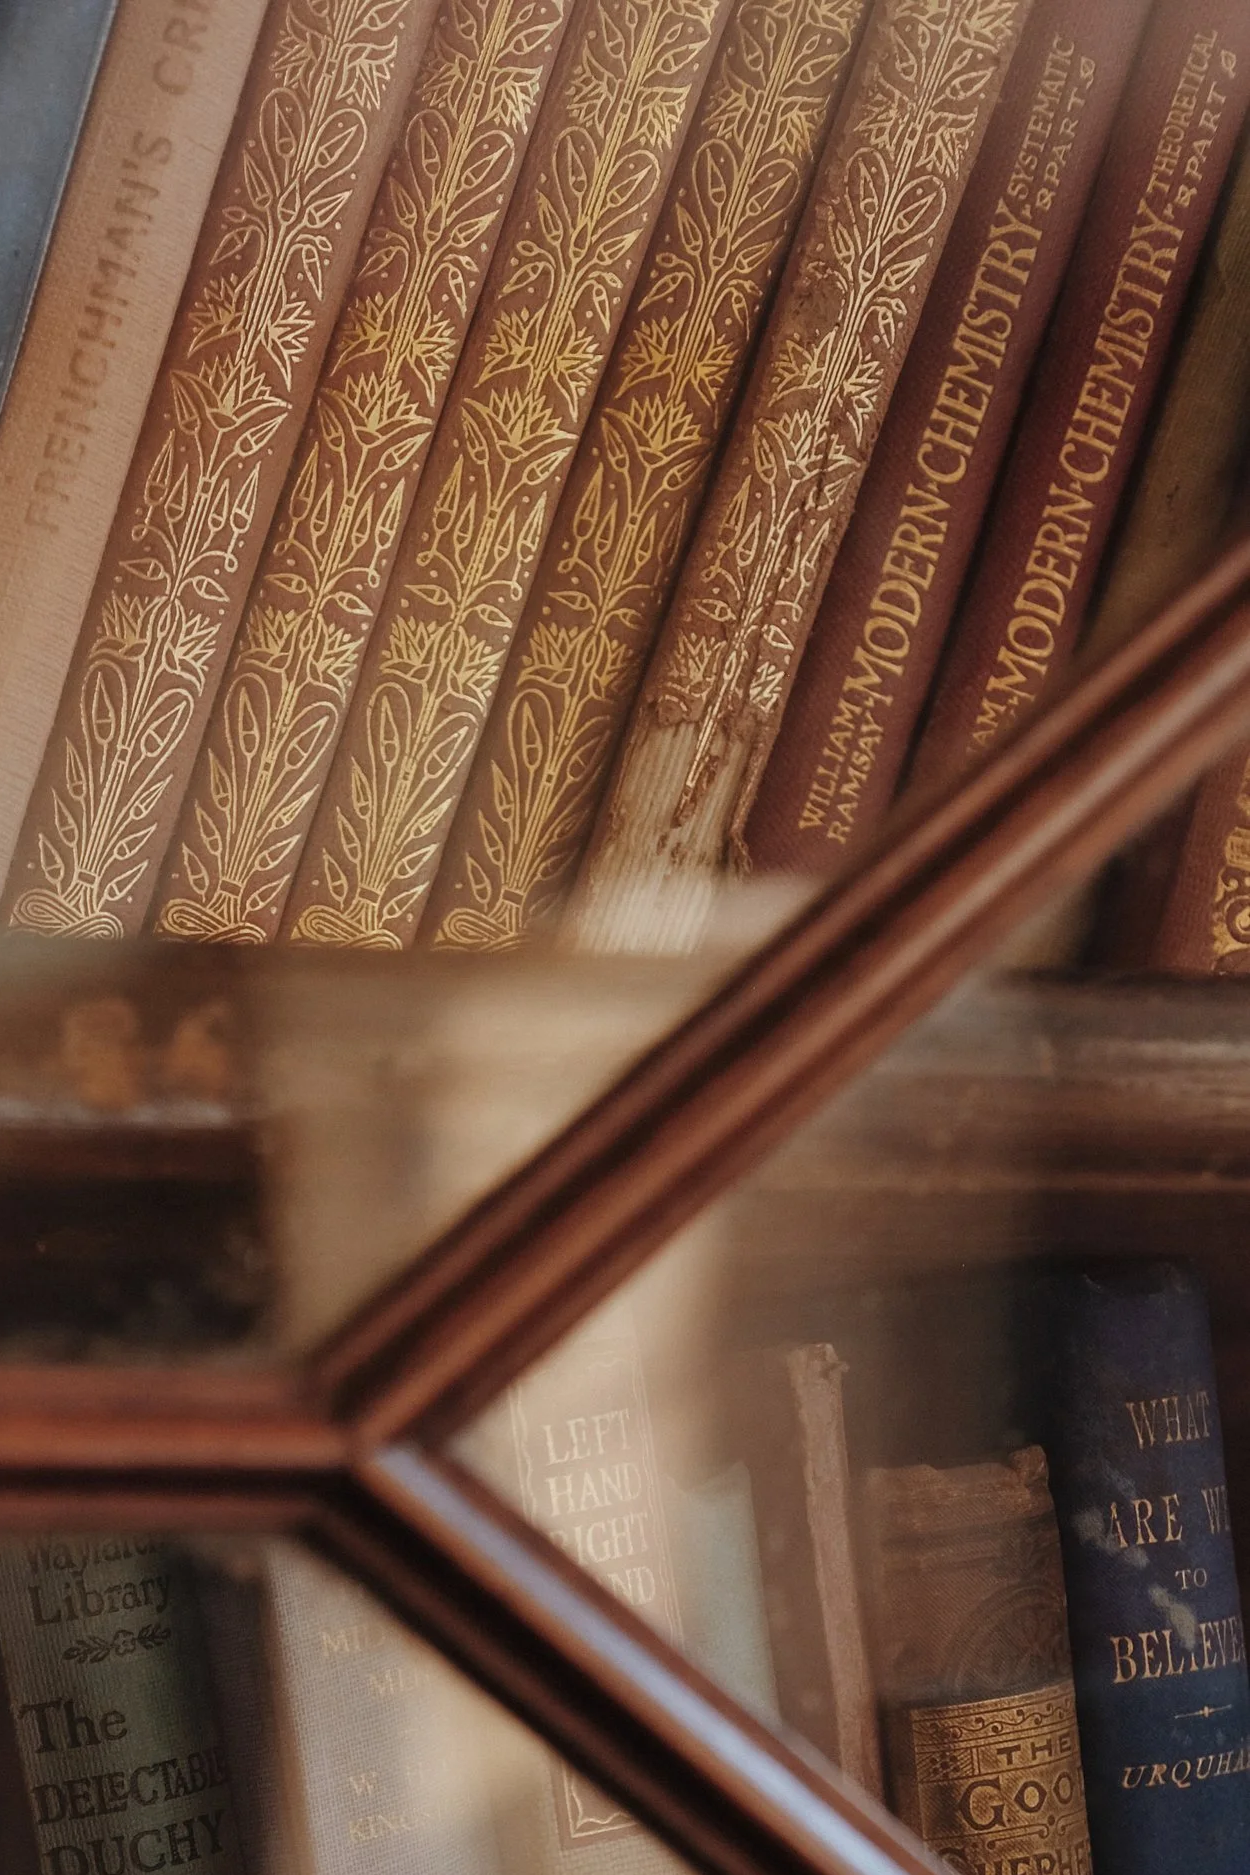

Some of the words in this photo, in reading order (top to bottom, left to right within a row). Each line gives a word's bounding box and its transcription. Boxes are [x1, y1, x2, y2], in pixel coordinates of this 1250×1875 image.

[1006, 35, 1076, 200] SYSTEMATIC
[1042, 93, 1088, 187] PART
[1148, 28, 1218, 200] THEORETICAL
[1187, 89, 1229, 182] PART
[25, 130, 174, 533] FRENCHMAN'S
[851, 481, 945, 705] MODERN
[915, 210, 1042, 484] CHEMISTRY
[986, 482, 1091, 702] MODERN
[1062, 206, 1188, 484] CHEMISTRY
[799, 701, 859, 830] WILLIAM
[826, 709, 880, 845] RAMSAY
[543, 1408, 630, 1466] LEFT
[1126, 1390, 1210, 1449] WHAT
[545, 1462, 643, 1517] HAND
[1110, 1493, 1183, 1548] ARE
[28, 1574, 172, 1627] Library
[1174, 1567, 1208, 1590] TO
[19, 1701, 129, 1755] The
[996, 1732, 1072, 1766] THE
